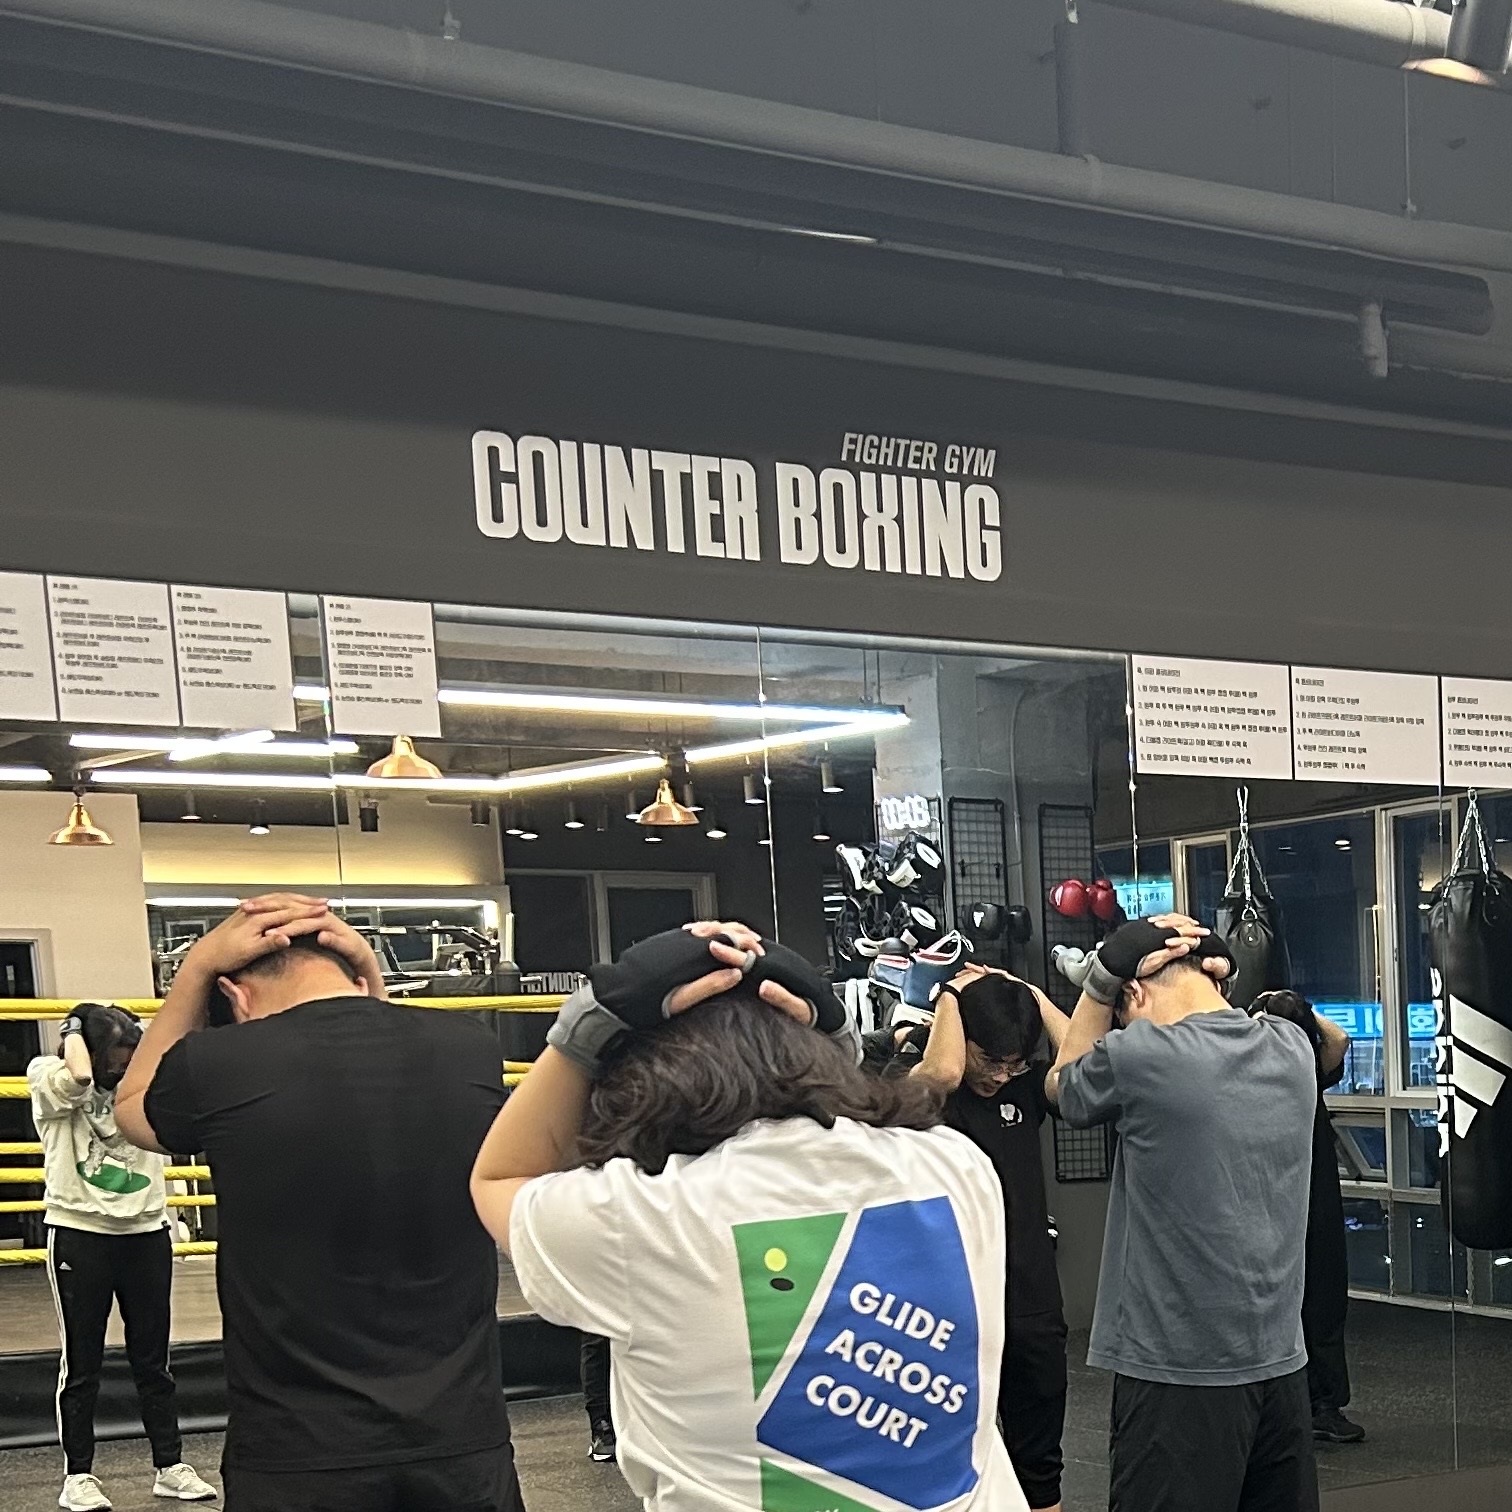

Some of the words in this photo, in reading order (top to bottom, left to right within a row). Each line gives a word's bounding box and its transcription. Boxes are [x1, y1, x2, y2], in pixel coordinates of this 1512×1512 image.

[840, 432, 938, 472] FIGHTER
[943, 444, 997, 478] GYM
[471, 430, 762, 561] COUNTER
[775, 461, 1003, 582] BOXING
[849, 1282, 956, 1352] GLIDE
[824, 1328, 968, 1414] ACROSS
[806, 1374, 929, 1449] COURT
